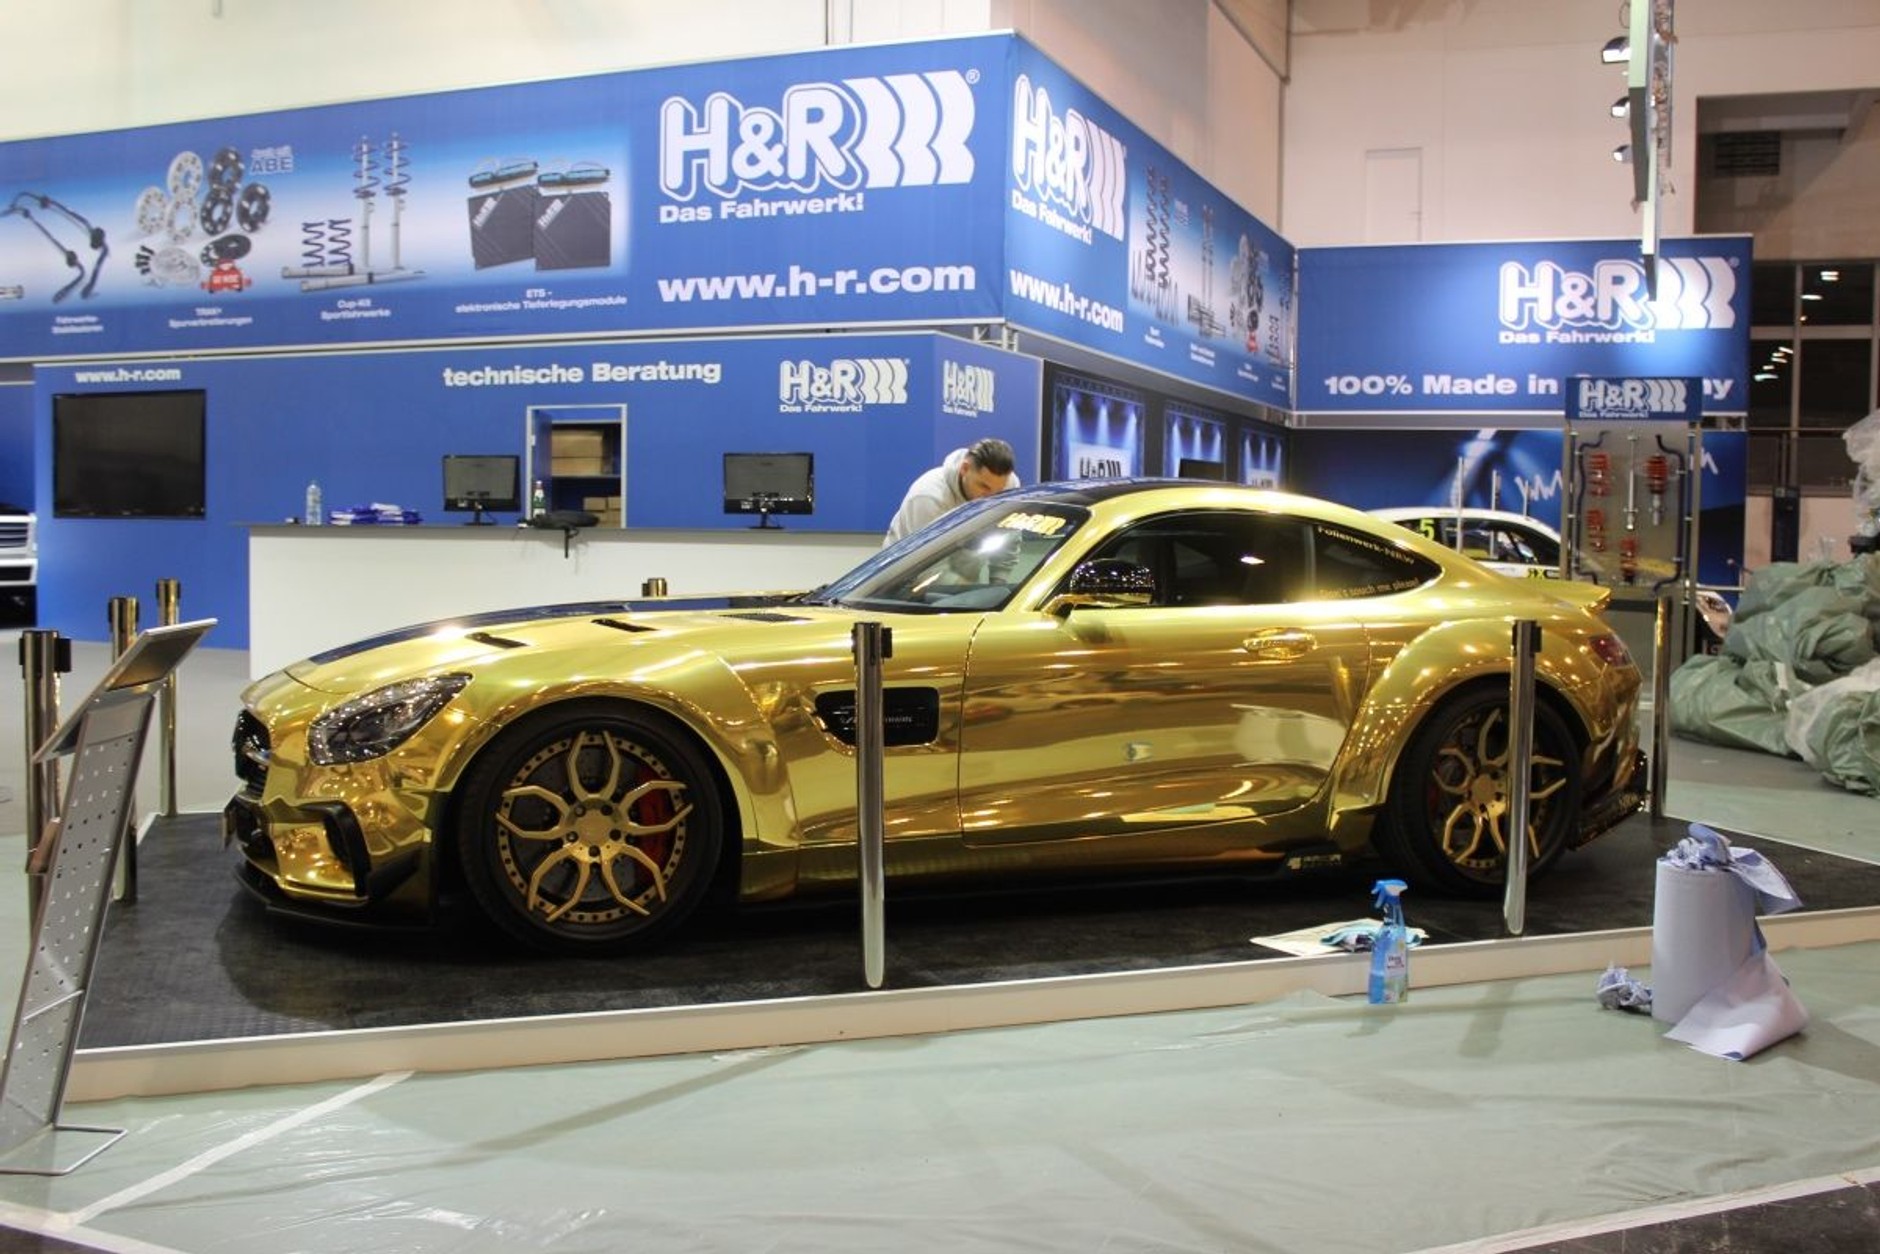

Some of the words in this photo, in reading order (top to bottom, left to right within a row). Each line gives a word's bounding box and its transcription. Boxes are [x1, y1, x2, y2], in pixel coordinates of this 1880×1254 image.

[660, 83, 863, 201] H&R
[1013, 73, 1093, 224] H&R
[251, 156, 293, 172] ABE
[660, 205, 712, 223] Das
[720, 192, 864, 219] Fahrwerk!
[1012, 189, 1037, 218] Das
[1039, 203, 1093, 246] Fahrwerk!
[658, 265, 976, 302] www.h-r.com
[1500, 260, 1656, 330] H&R
[1010, 269, 1124, 333] www.h-r.com
[1500, 331, 1540, 344] Das
[75, 368, 181, 383] www.h-r.com
[443, 364, 584, 386] technische
[592, 361, 721, 383] Beratung
[780, 359, 865, 404] H&R
[943, 359, 979, 410] H&R
[1325, 375, 1412, 395] 100%
[1423, 374, 1517, 395] Made
[1528, 374, 1558, 394] in
[779, 404, 801, 413] Das
[1579, 379, 1651, 412] H&R
[1418, 518, 1435, 540] 5
